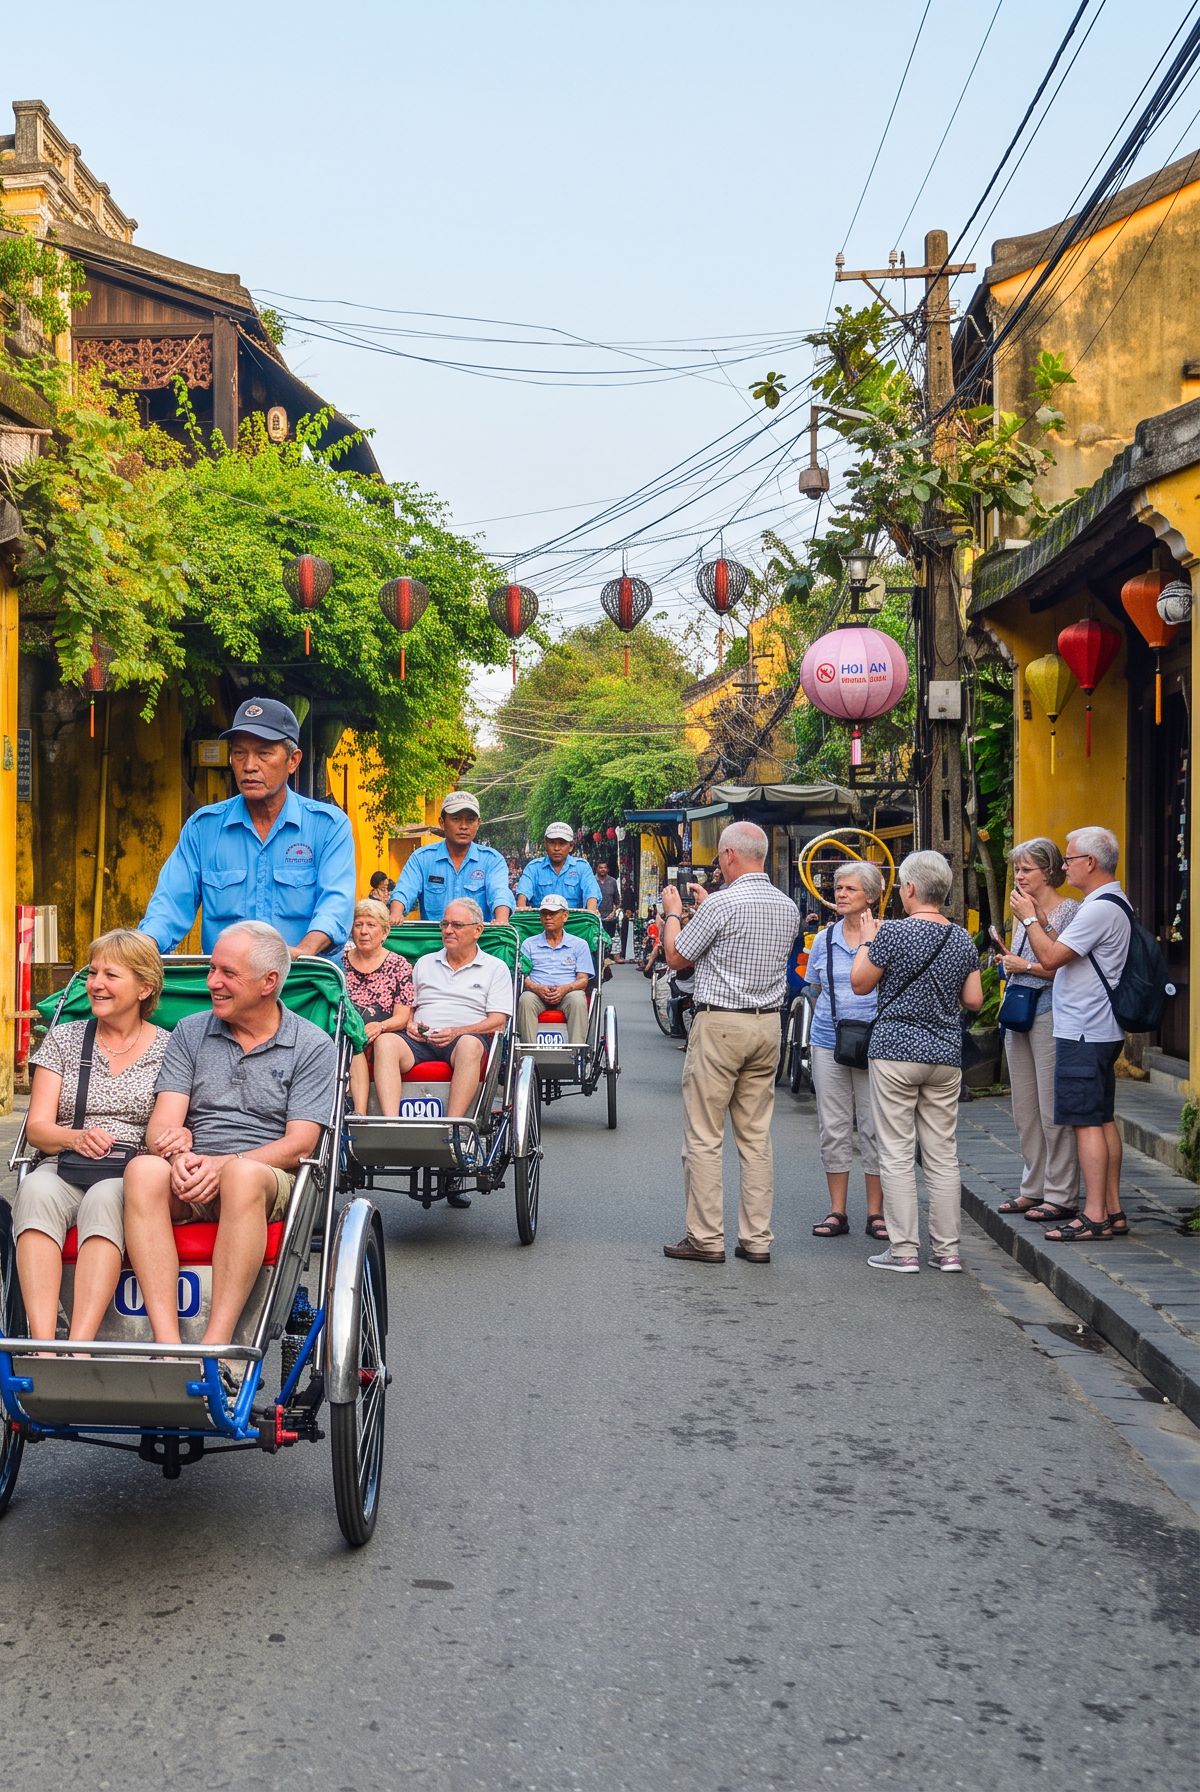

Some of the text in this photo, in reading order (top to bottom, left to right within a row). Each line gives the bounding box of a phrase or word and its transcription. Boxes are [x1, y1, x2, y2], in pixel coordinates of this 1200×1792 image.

[841, 662, 887, 674] HOI AN
[124, 1275, 192, 1312] 00
